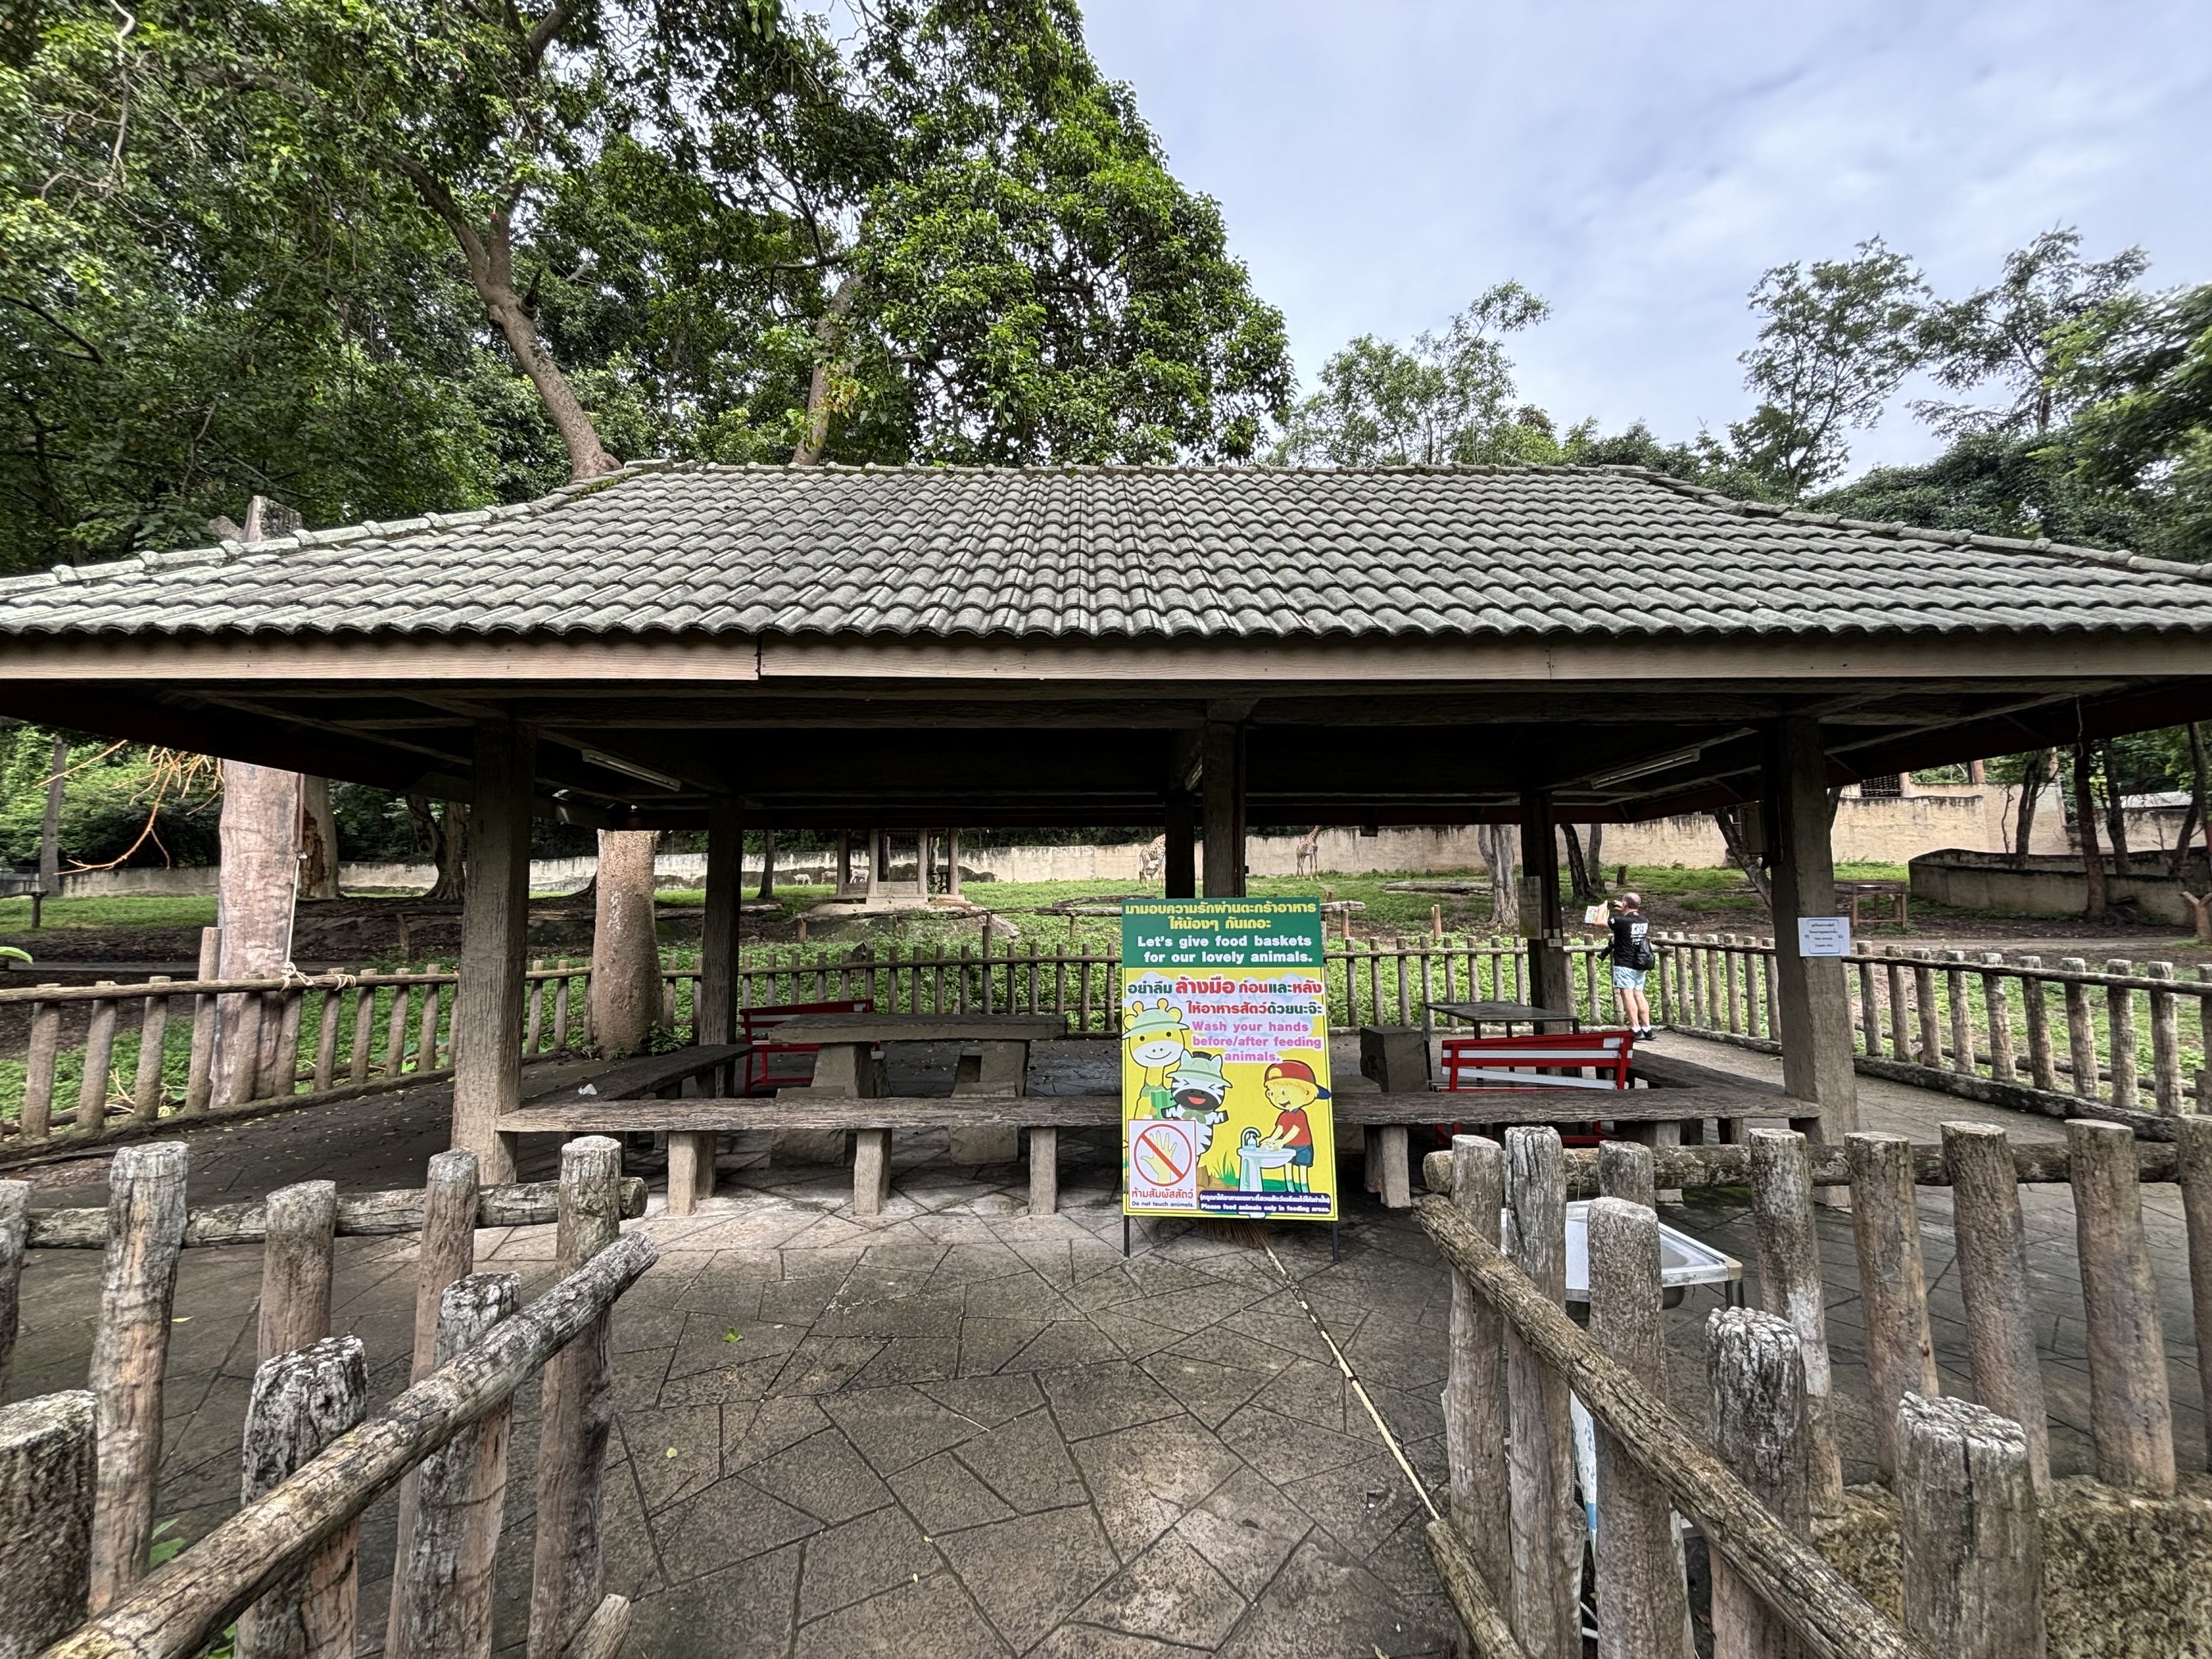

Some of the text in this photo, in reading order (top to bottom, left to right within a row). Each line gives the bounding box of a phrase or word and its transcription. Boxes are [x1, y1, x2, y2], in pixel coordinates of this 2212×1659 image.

[1125, 900, 1316, 915] มามอบความรักผ่านตะกร้าอาหาร
[1167, 916, 1272, 932] ให้น้องๆ กันเถอะ
[1179, 935, 1209, 949] give
[1215, 935, 1247, 947] food
[1253, 935, 1312, 946] baskets
[1144, 950, 1313, 965] for our lovely animals.
[1128, 980, 1173, 994] อย่าลืม
[1175, 975, 1236, 995] ล้างมือ
[1192, 1022, 1310, 1033] Wash your hands
[1193, 1035, 1322, 1049] before/after feeding
[1224, 1051, 1281, 1062] animals.
[1131, 1187, 1194, 1199] ห้ามสัมผัสสัตว์
